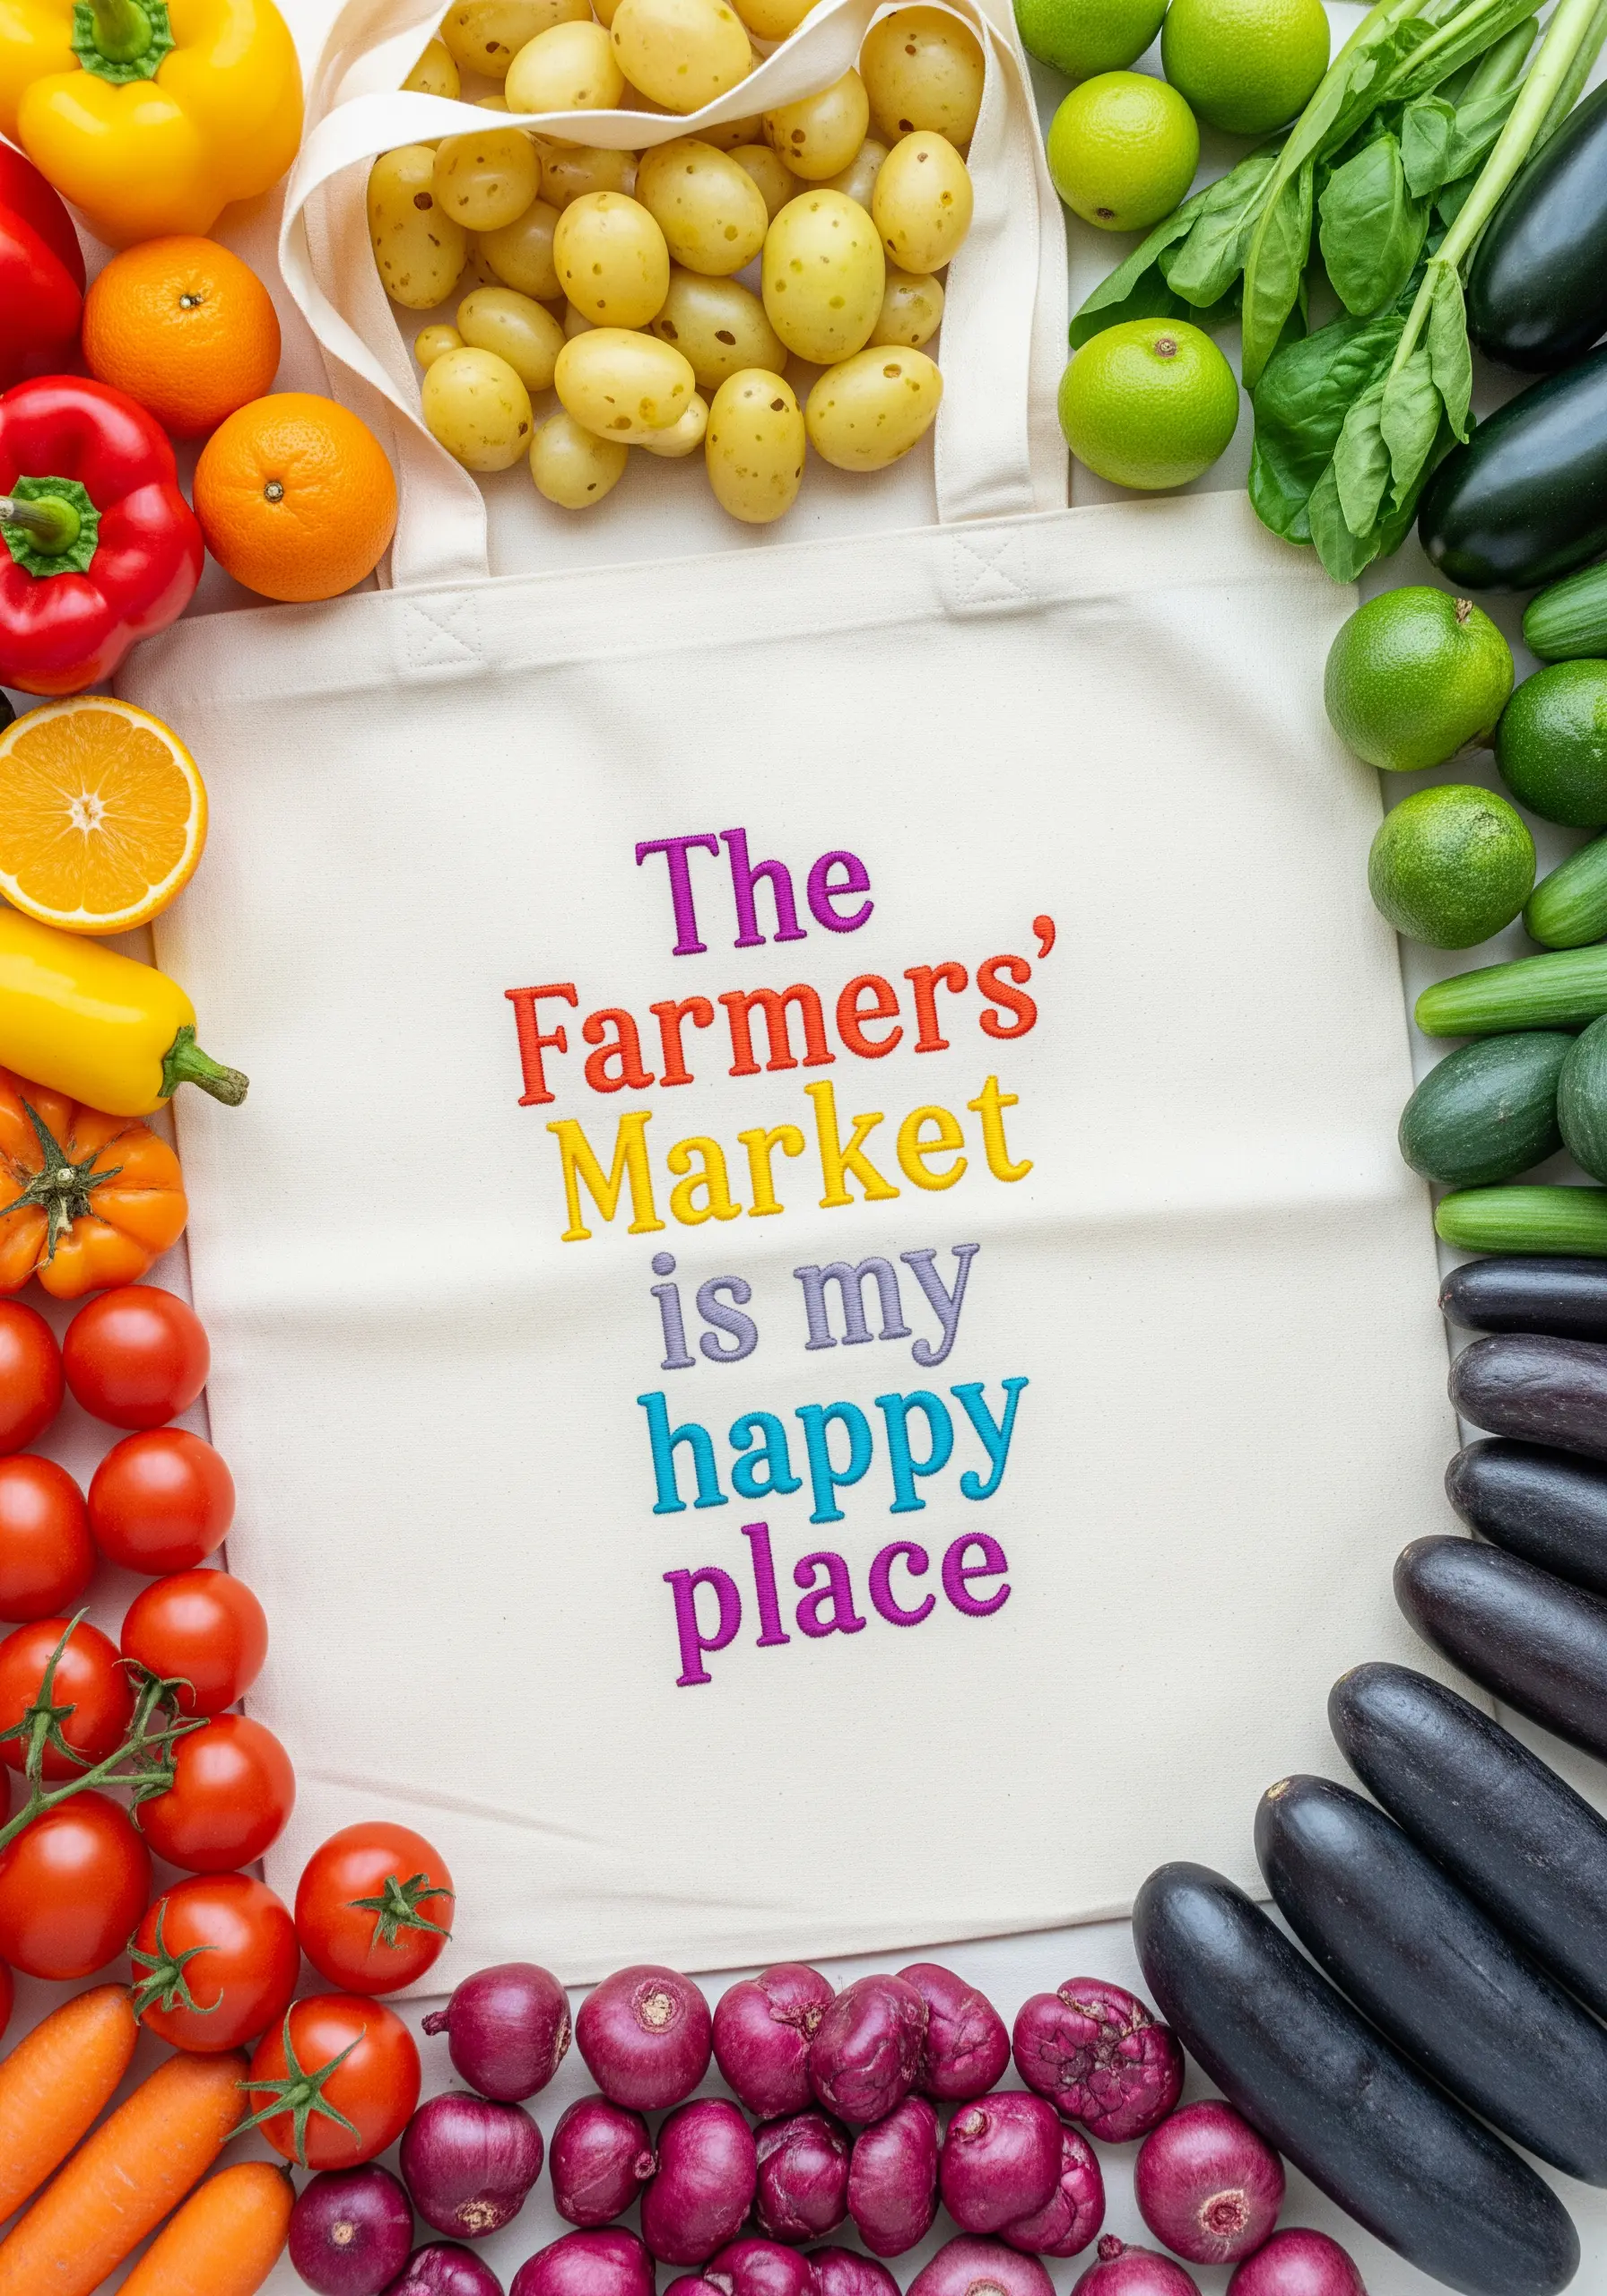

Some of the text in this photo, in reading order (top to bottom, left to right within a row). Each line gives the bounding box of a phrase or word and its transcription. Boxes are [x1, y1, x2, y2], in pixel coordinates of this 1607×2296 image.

[635, 828, 874, 956] The
[545, 1074, 1034, 1242] Market
[651, 1243, 980, 1370] is my
[637, 1377, 1029, 1524] happy
[663, 1522, 1011, 1686] place
